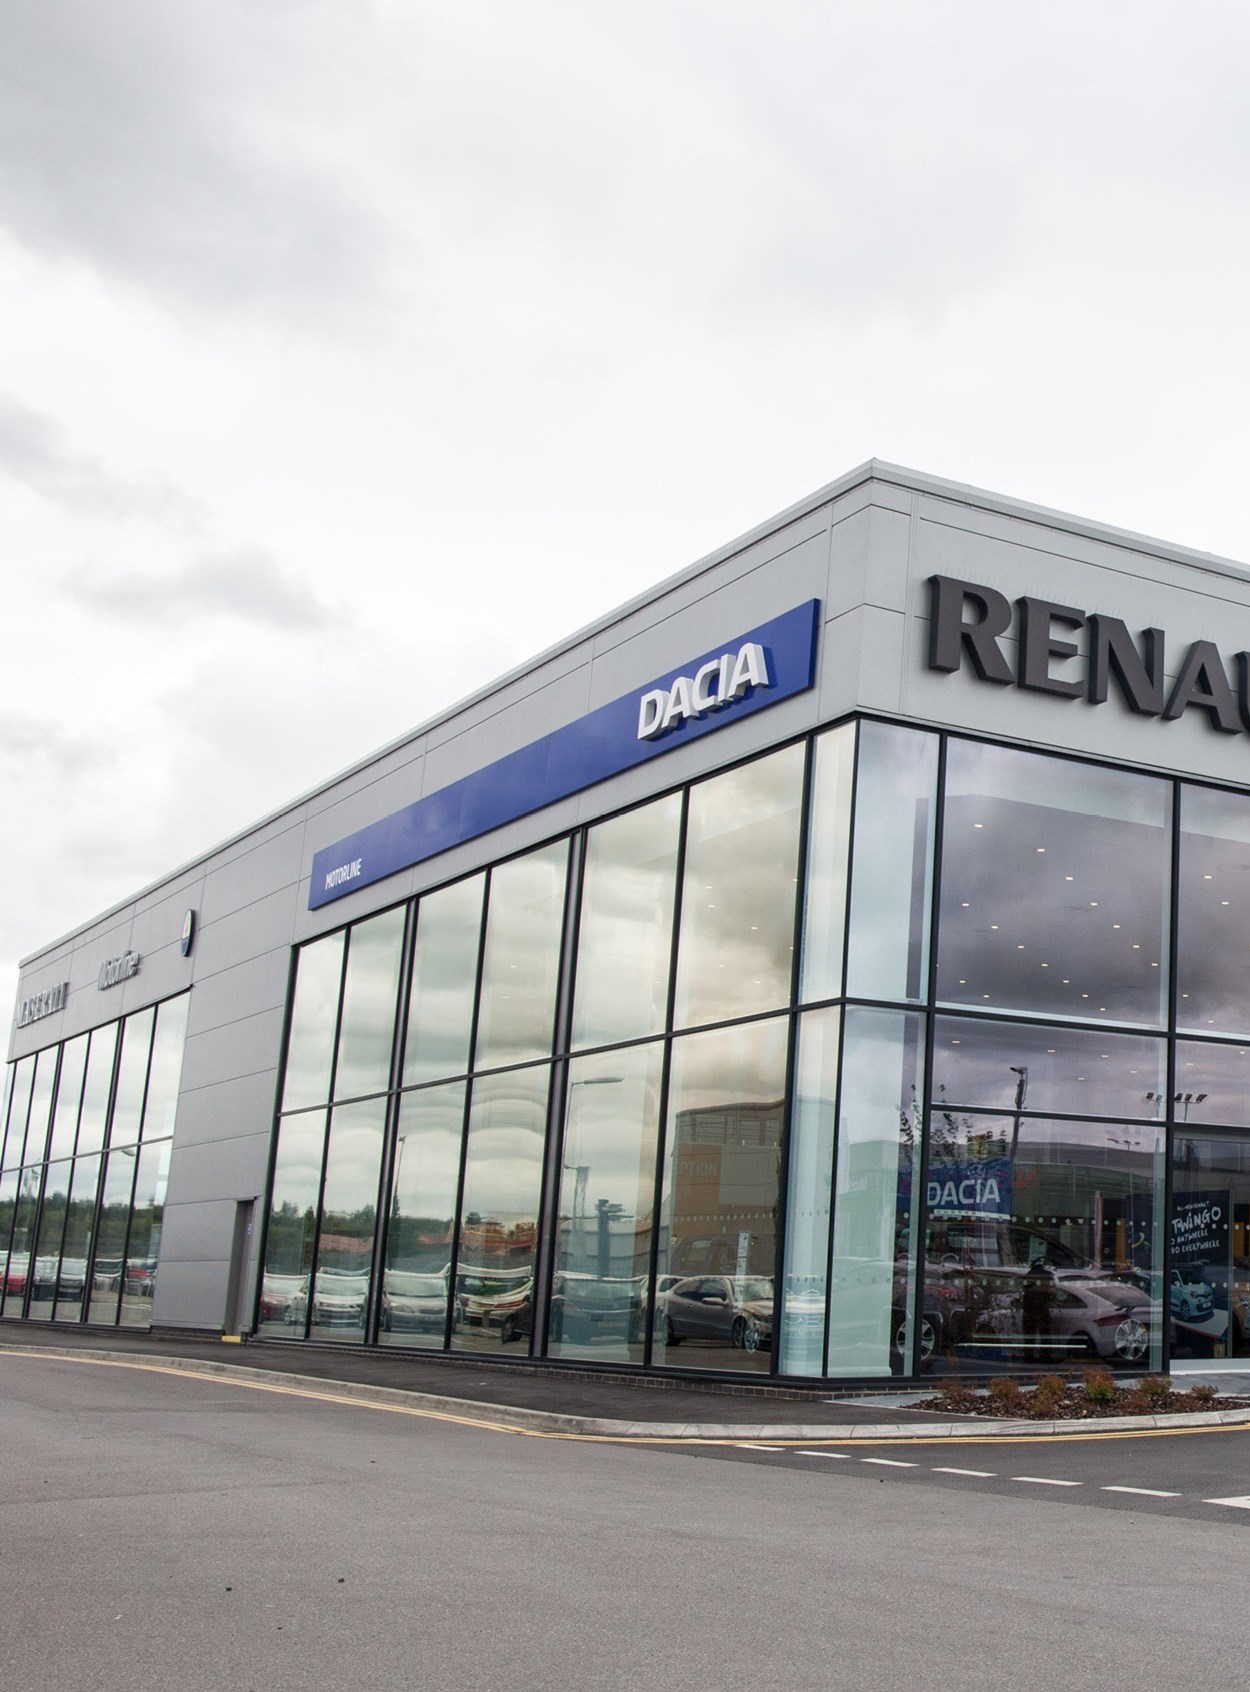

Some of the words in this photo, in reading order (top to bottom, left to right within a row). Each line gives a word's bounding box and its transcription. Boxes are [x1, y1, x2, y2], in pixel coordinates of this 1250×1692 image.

[637, 642, 769, 740] DACIA
[325, 858, 362, 891] MOTORLINE
[927, 1178, 1001, 1206] DACIA
[1177, 1229, 1208, 1244] ANYWHERE
[1181, 1239, 1220, 1253] EVERYWHERE
